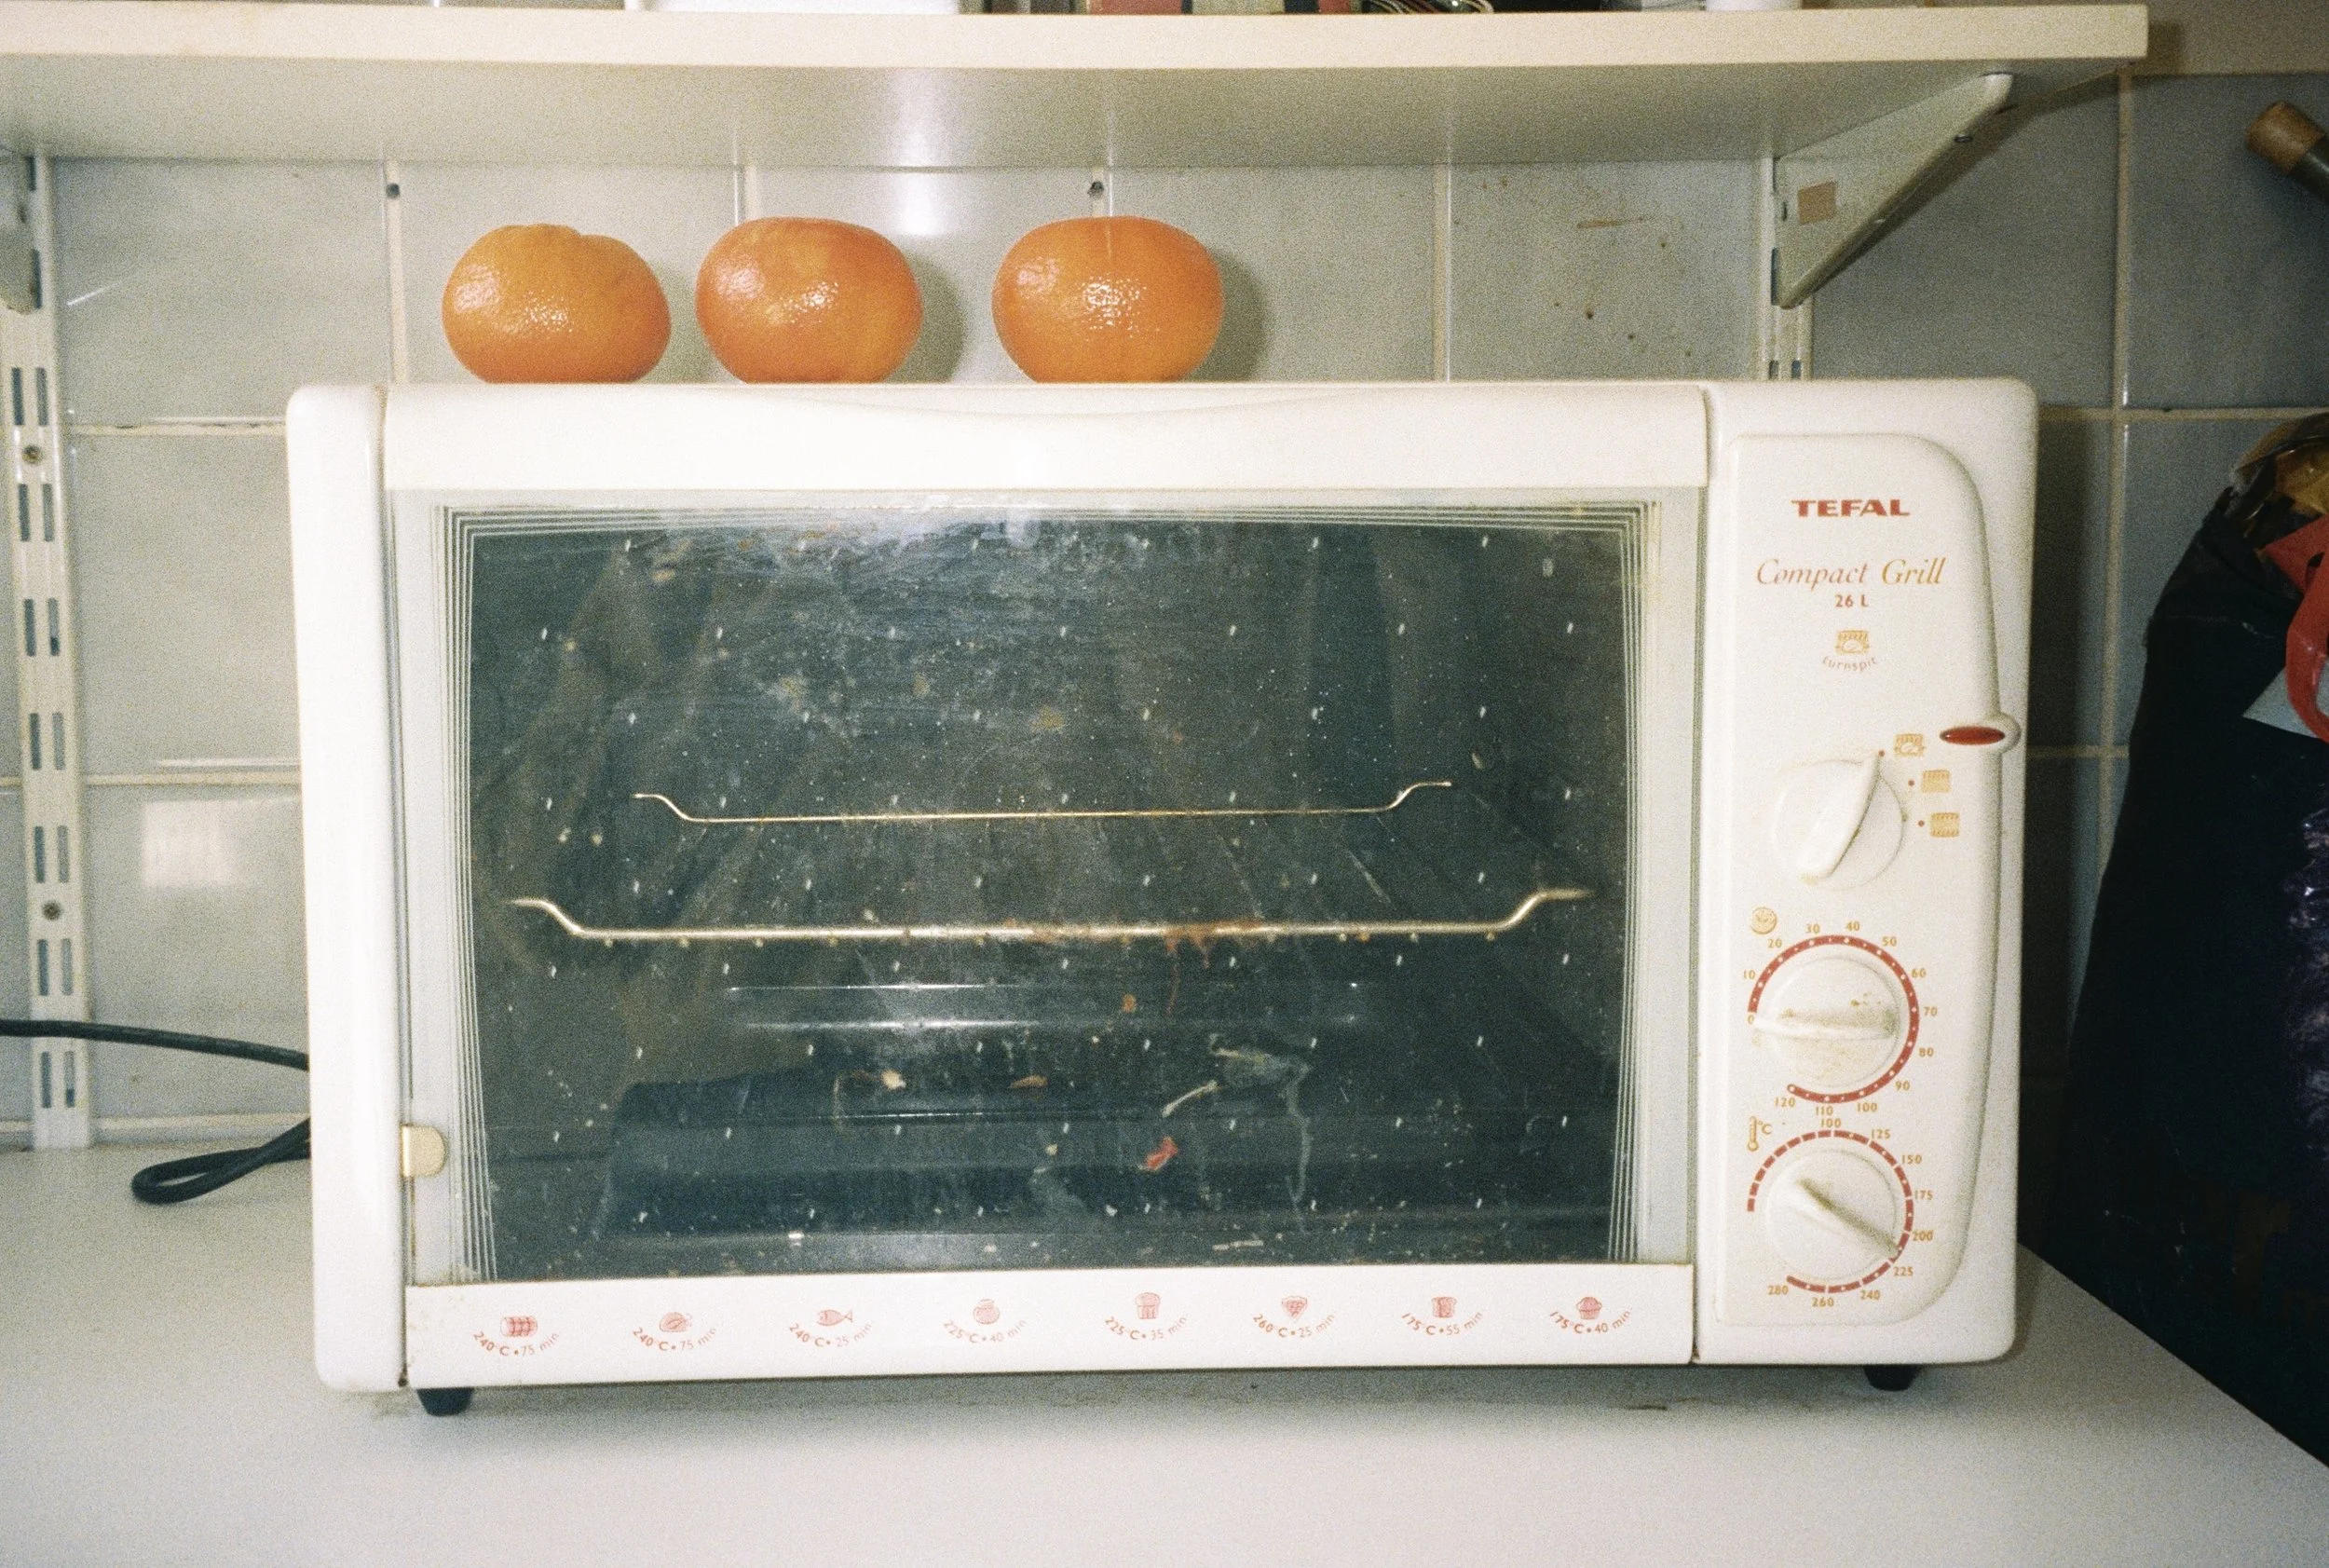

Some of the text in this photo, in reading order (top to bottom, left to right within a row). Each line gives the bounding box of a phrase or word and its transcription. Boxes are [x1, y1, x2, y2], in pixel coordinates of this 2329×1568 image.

[1791, 498, 1910, 517] TEFAL
[1756, 557, 1946, 591] Compact Grill
[1834, 594, 1869, 607] 26 L
[1806, 923, 1820, 934] 30
[1845, 921, 1860, 932] 40
[1768, 938, 1782, 948] 20
[1883, 936, 1897, 947] 50
[1744, 970, 1756, 980] 10
[1912, 969, 1927, 978] 60
[1925, 1006, 1938, 1016] 70
[1918, 1048, 1934, 1057] 80
[1896, 1082, 1911, 1091] 90
[1775, 1097, 1796, 1108] 120
[1858, 1102, 1878, 1112] 100
[1816, 1105, 1833, 1116] 110
[1821, 1118, 1842, 1128] 100
[1871, 1128, 1891, 1139] 125
[1902, 1154, 1922, 1165] 150
[1914, 1191, 1933, 1201] 175
[1912, 1231, 1933, 1241] 200
[1894, 1266, 1914, 1276] 225
[1767, 1285, 1789, 1295] 280
[1861, 1290, 1881, 1301] 240
[1813, 1298, 1834, 1307] 260
[1298, 1326, 1312, 1339] 25
[1446, 1324, 1461, 1336] 55
[1593, 1322, 1609, 1333] 40
[836, 1335, 850, 1348] 25
[989, 1332, 1004, 1343] 40
[521, 1345, 535, 1357] 75
[681, 1340, 694, 1351] 75
